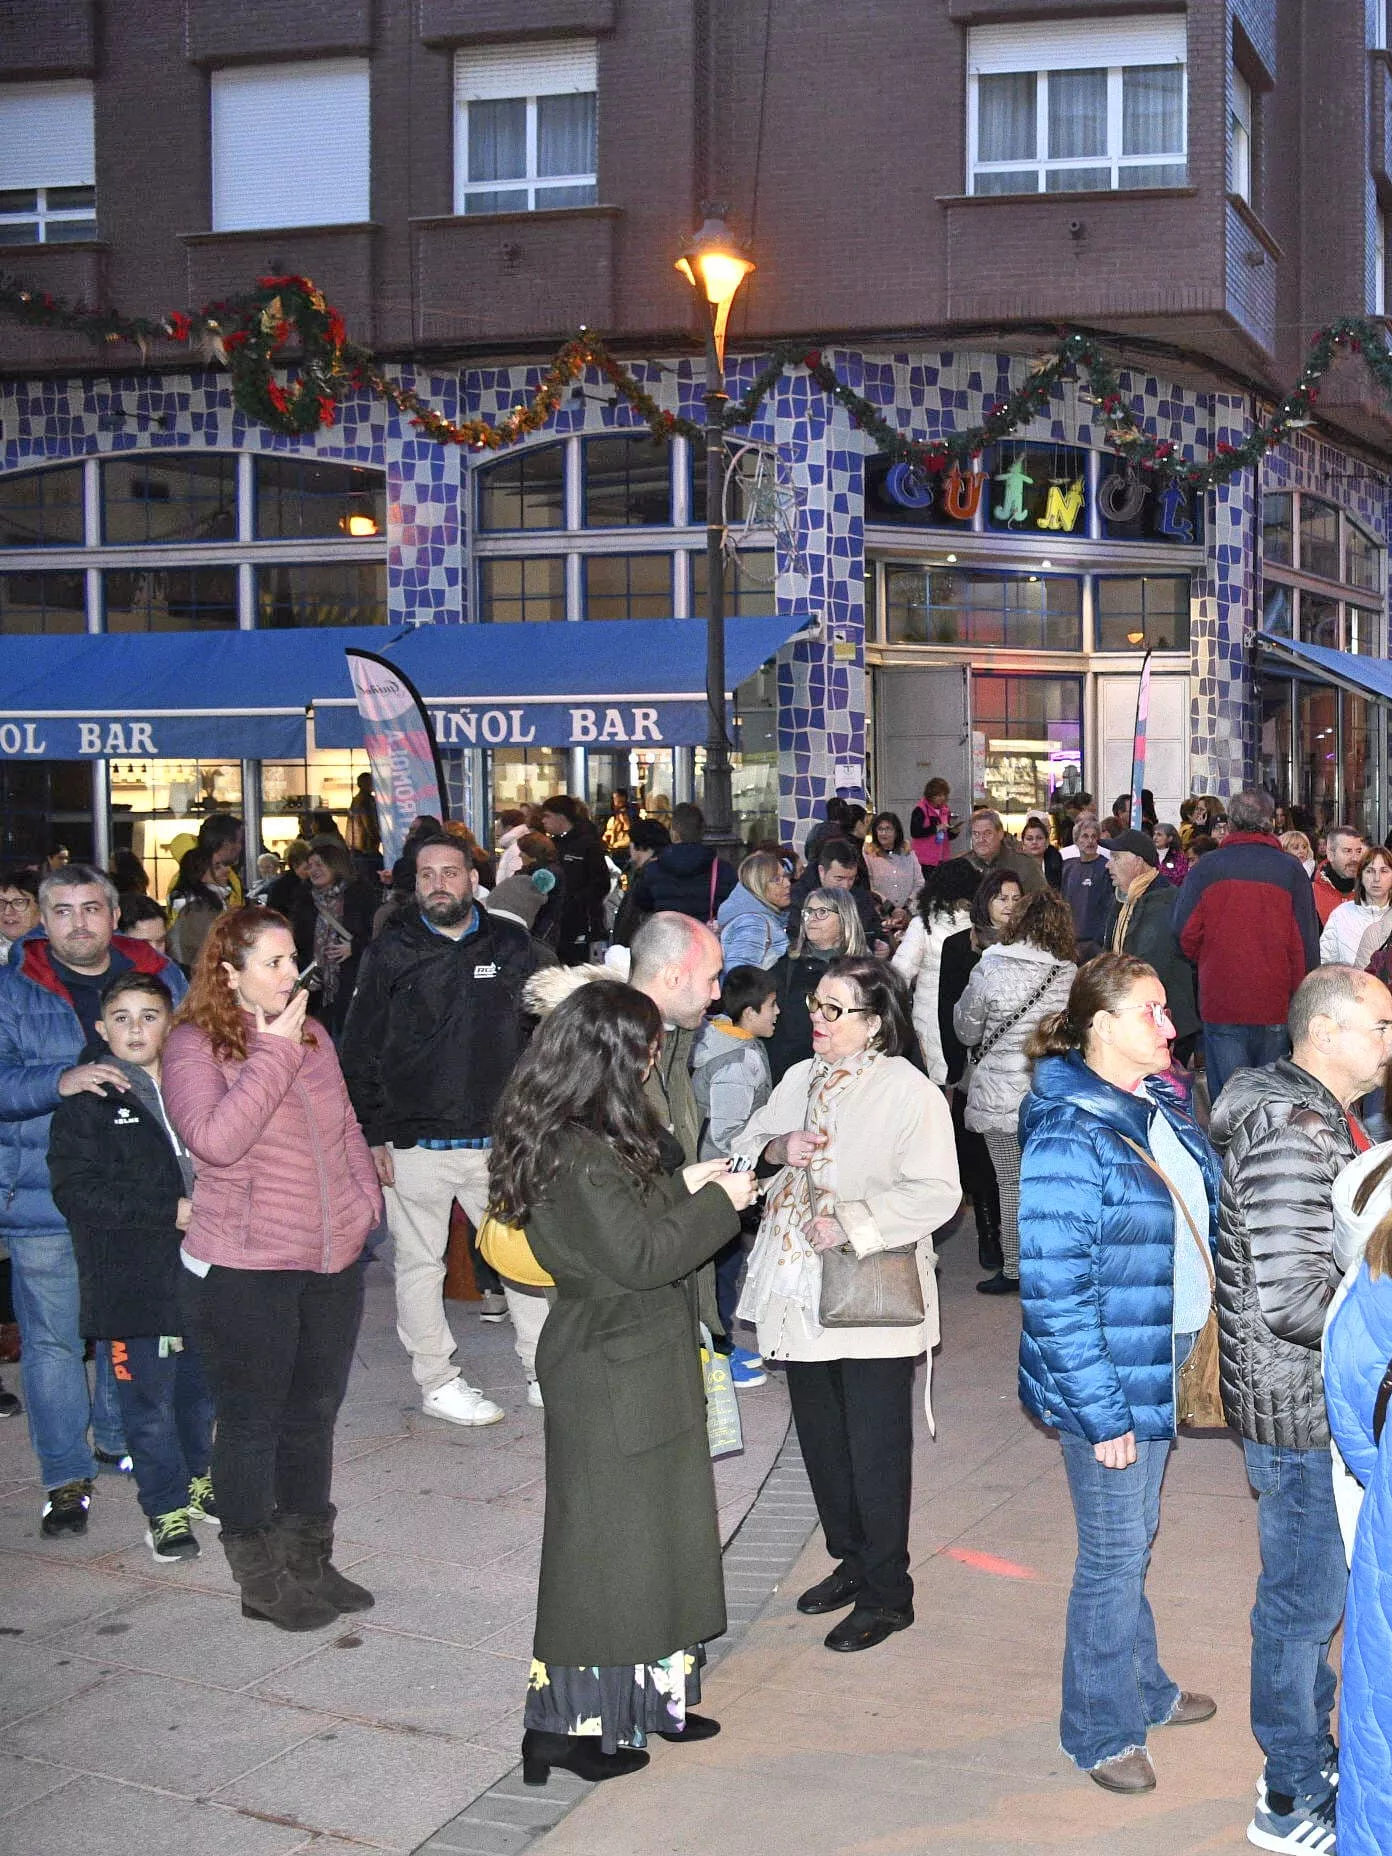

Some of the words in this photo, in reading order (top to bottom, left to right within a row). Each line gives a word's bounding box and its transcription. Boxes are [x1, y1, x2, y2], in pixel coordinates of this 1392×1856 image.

[78, 722, 159, 754] BAR
[428, 707, 536, 743] IÑOL
[569, 707, 664, 742] BAR
